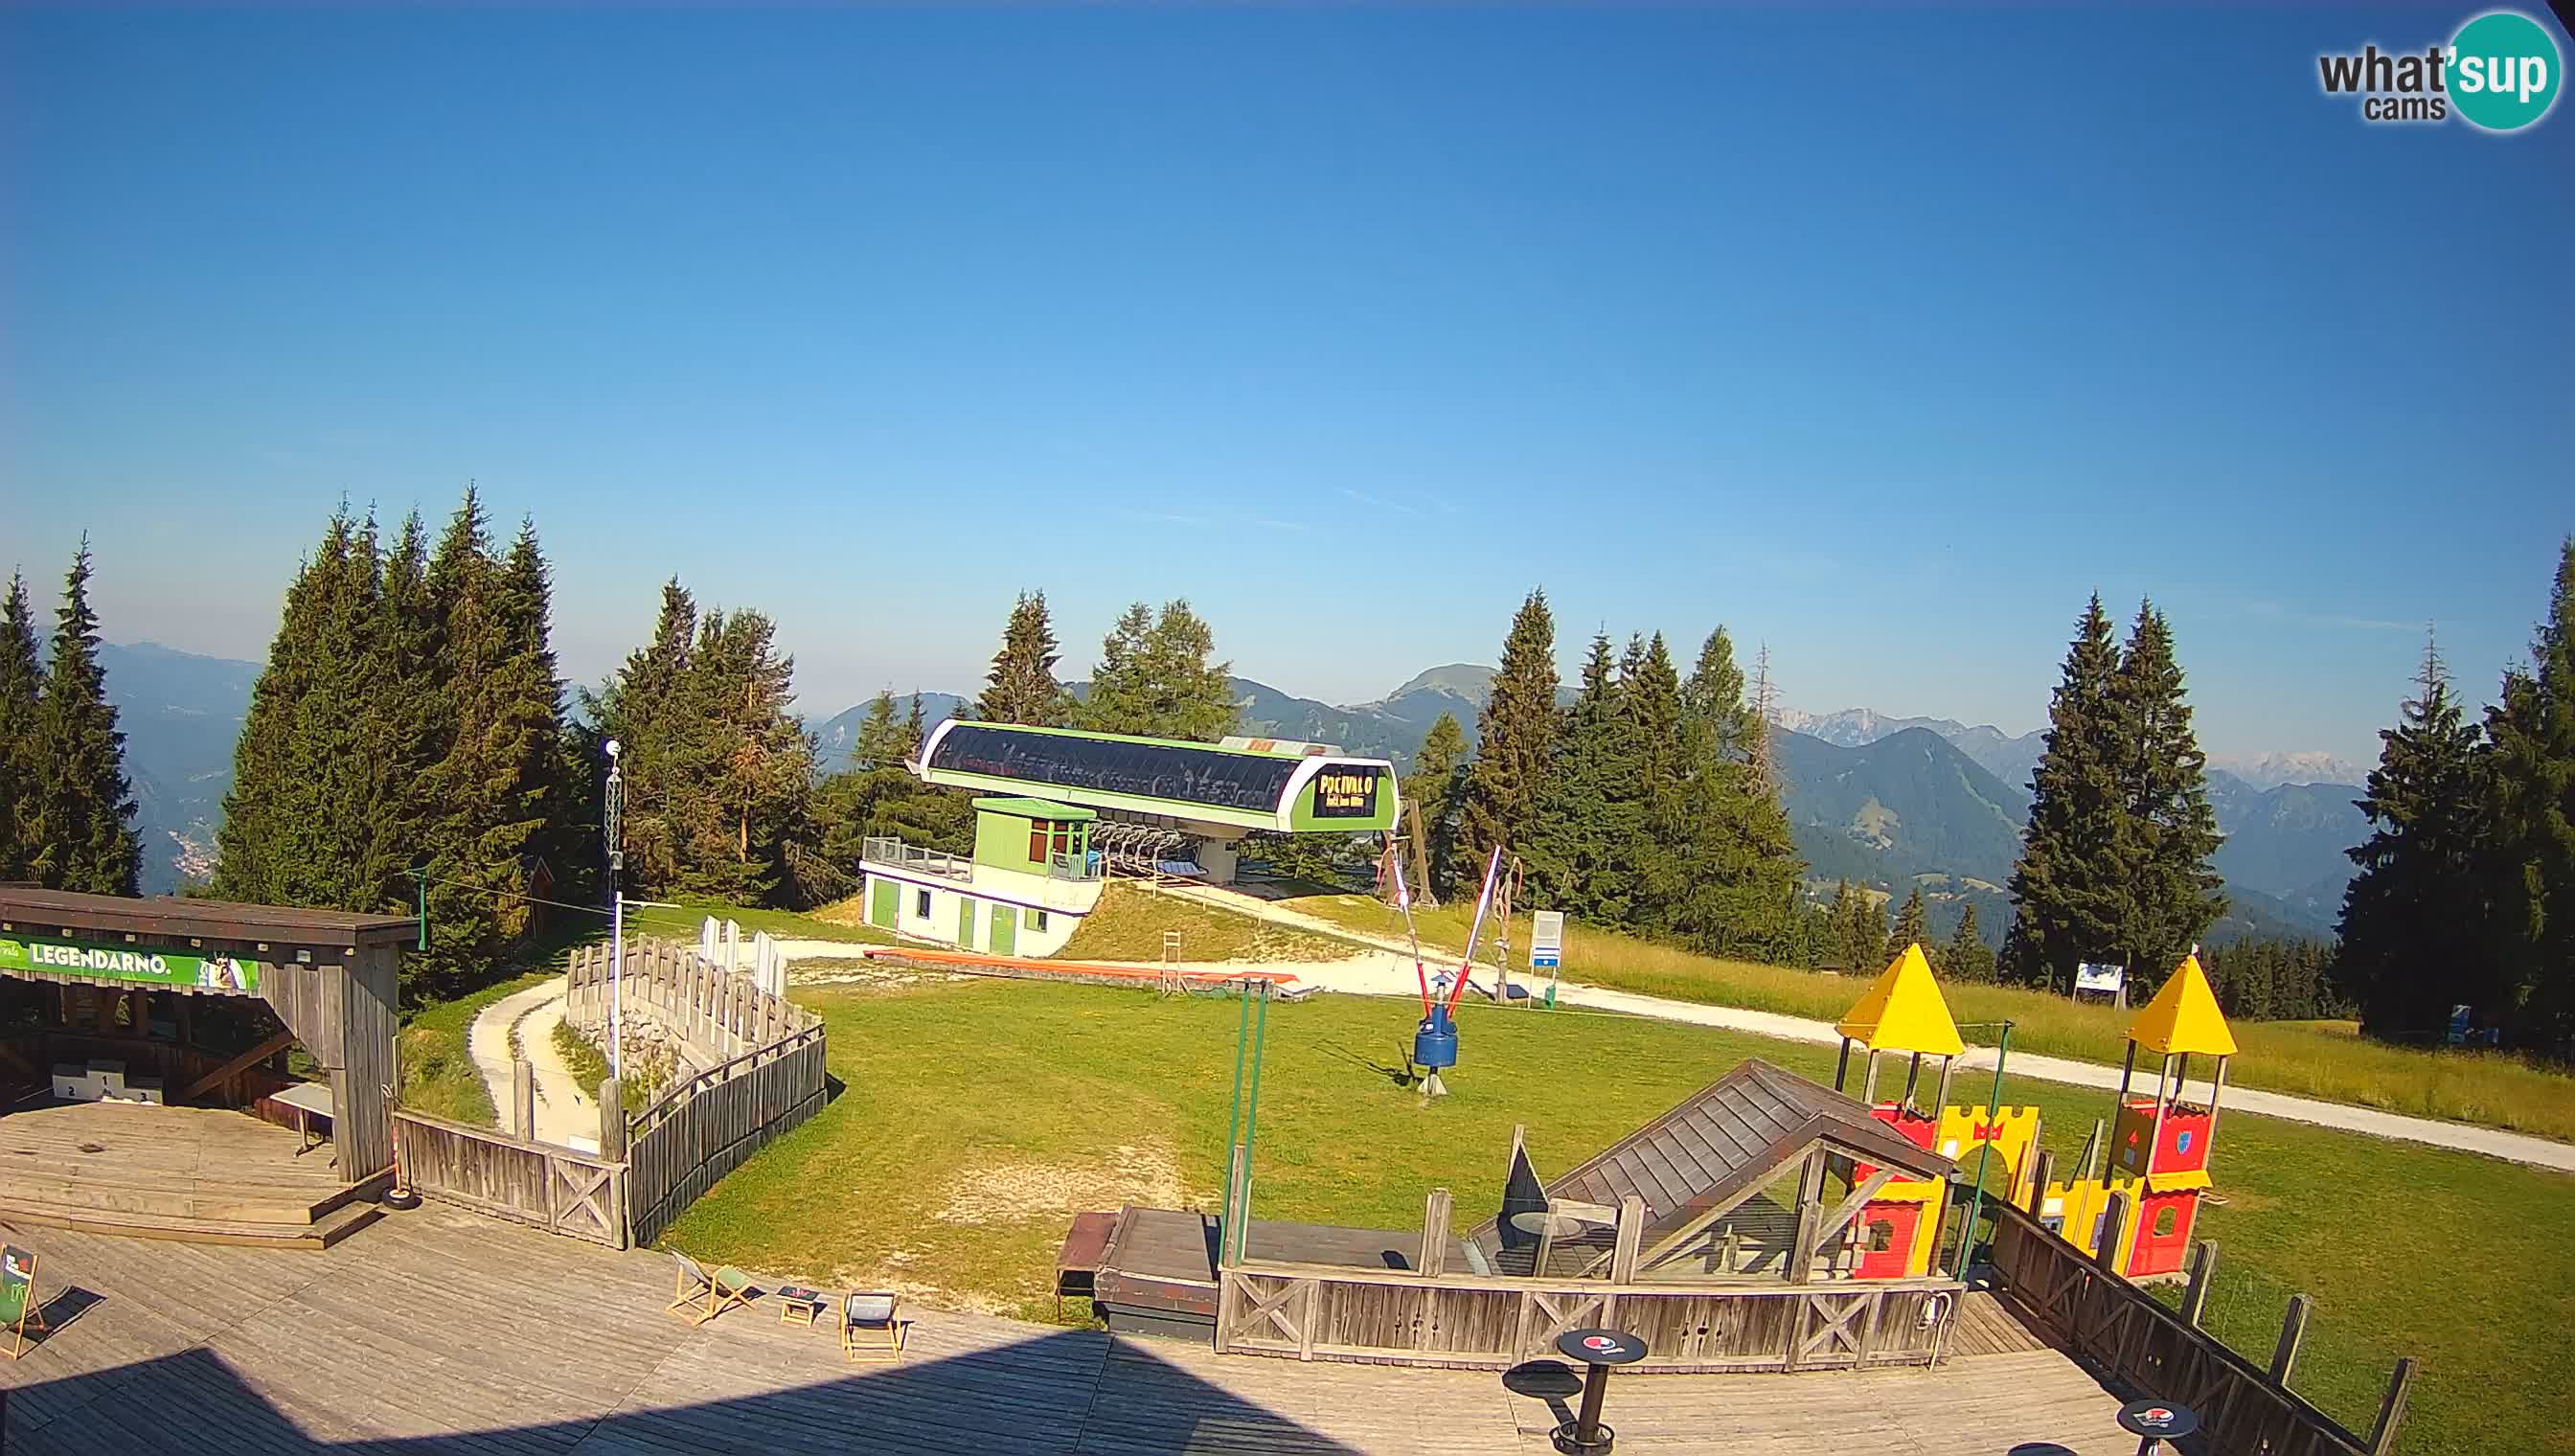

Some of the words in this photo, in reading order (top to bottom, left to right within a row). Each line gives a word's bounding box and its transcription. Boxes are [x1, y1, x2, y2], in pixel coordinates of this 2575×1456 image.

[30, 944, 172, 975] LEGENDARNO.
[102, 1075, 108, 1086] 1
[68, 1085, 76, 1097] 2
[140, 1092, 148, 1103] 3
